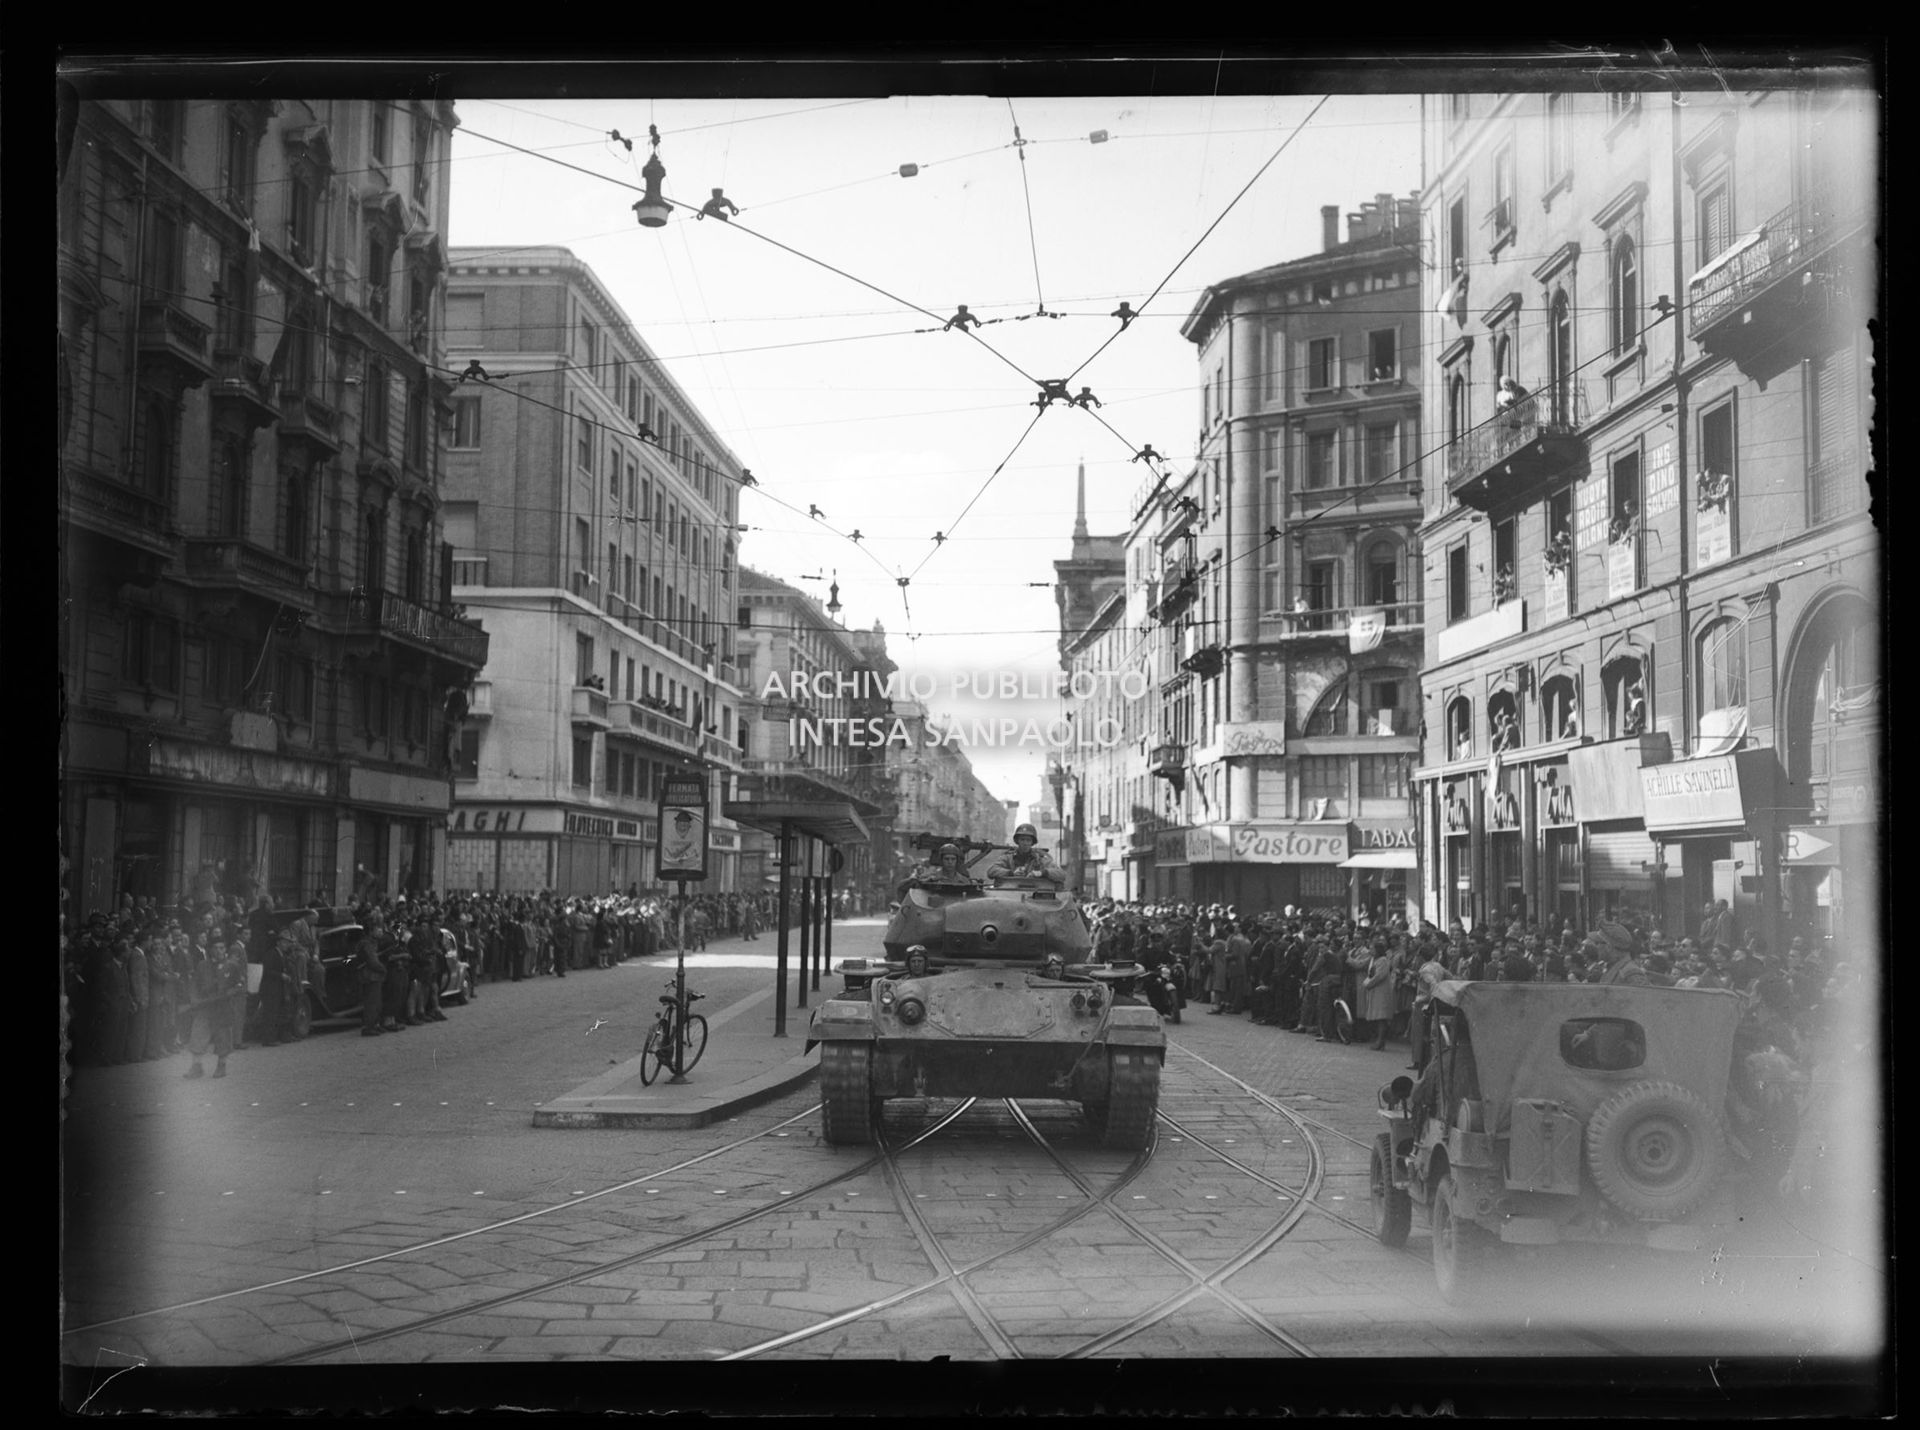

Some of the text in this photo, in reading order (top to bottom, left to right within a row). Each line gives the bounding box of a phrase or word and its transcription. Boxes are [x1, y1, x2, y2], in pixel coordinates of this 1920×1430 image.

[1577, 476, 1607, 510] NUOVA
[1649, 464, 1675, 494] DINO
[1577, 519, 1608, 553] MILANO
[668, 783, 699, 793] FERMATA
[1646, 767, 1735, 797] ACHILLE SAVINELLI
[1234, 828, 1343, 856] Pastore
